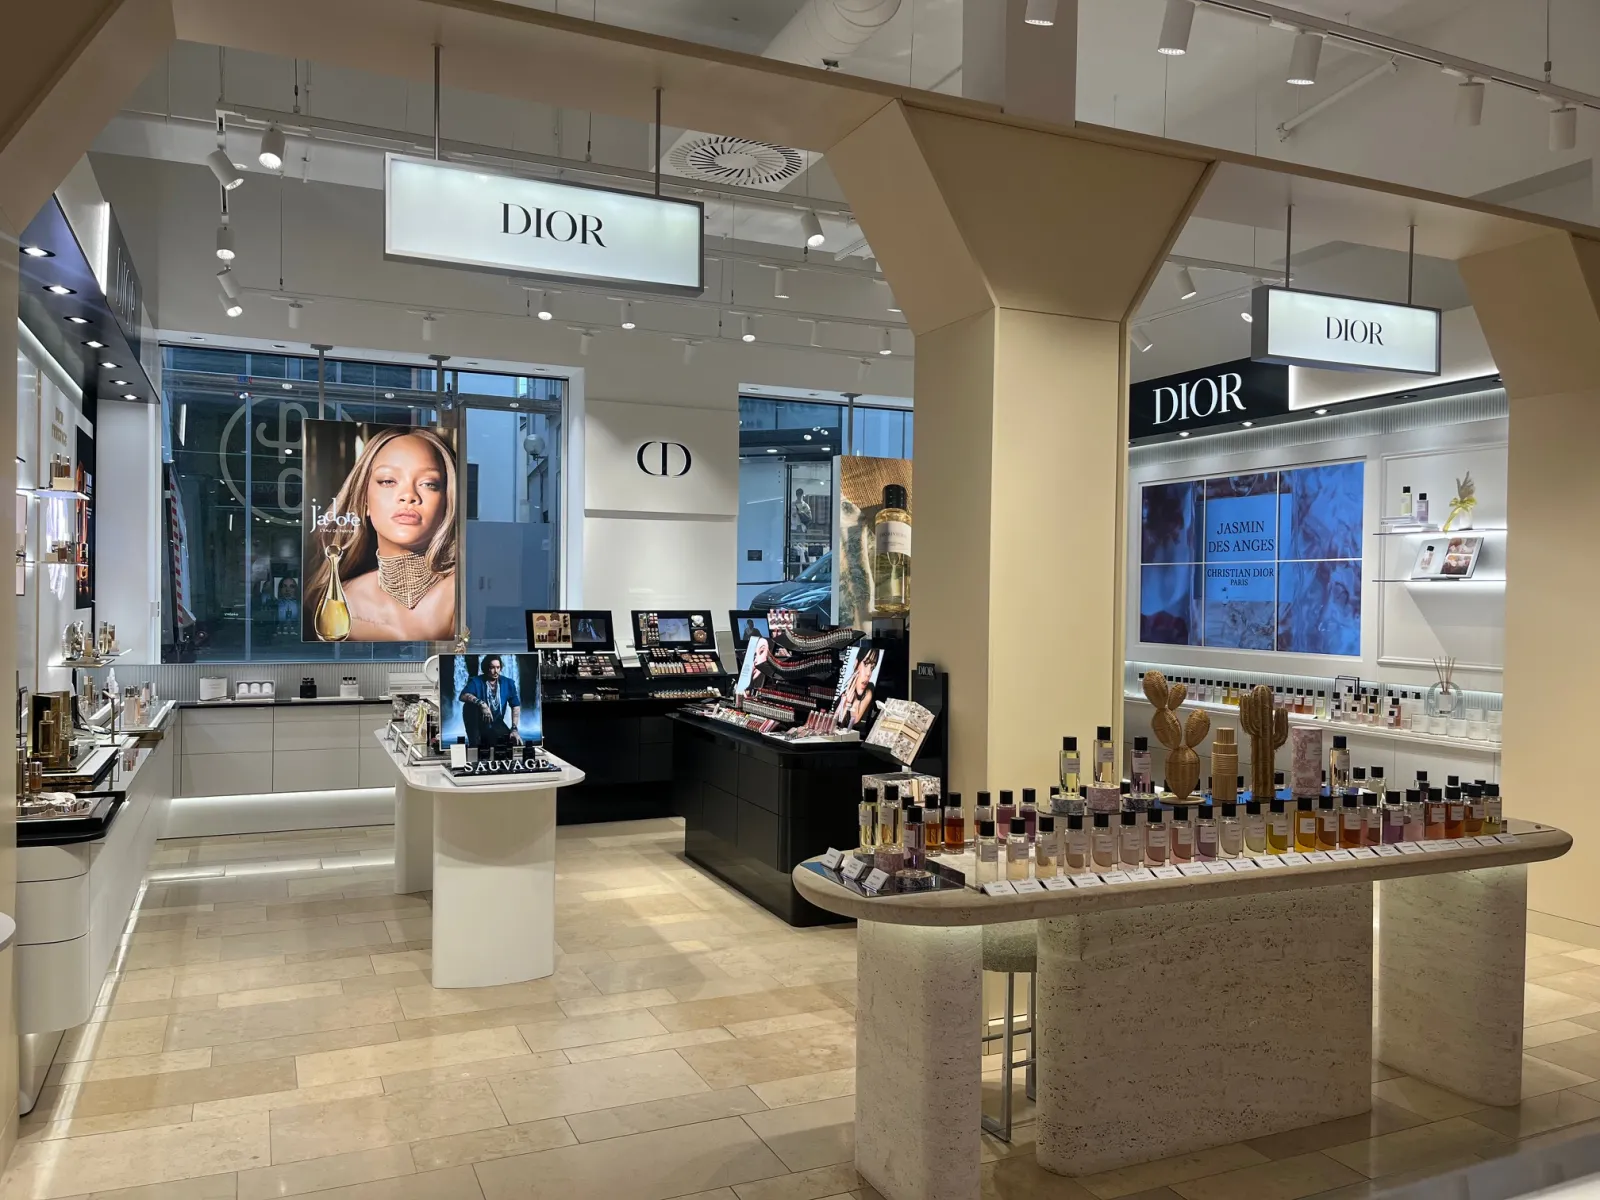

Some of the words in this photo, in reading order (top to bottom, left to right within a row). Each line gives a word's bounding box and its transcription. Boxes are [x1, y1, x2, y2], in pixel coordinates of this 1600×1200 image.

[499, 202, 607, 248] DIOR
[1326, 316, 1384, 346] DIOR
[1152, 372, 1247, 426] DIOR
[310, 498, 361, 533] j'adore
[1216, 520, 1265, 535] JASMIN
[1208, 540, 1230, 553] DES
[1233, 538, 1274, 552] ANGES
[1207, 568, 1251, 578] CHRISTIAN
[1252, 567, 1274, 577] DIOR
[918, 665, 934, 676] DIOR
[464, 758, 550, 772] SAUVAGE
